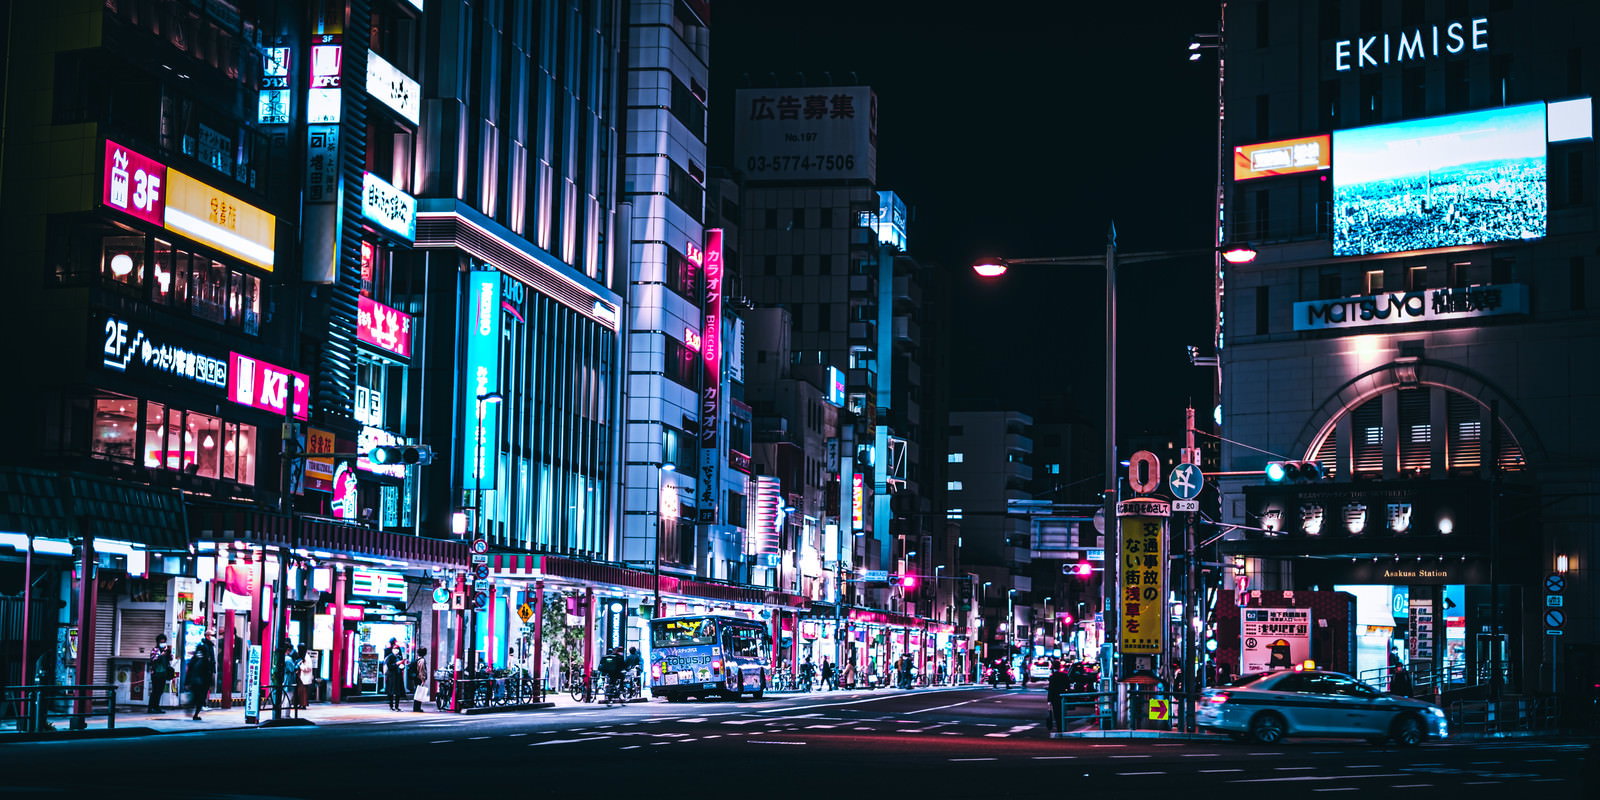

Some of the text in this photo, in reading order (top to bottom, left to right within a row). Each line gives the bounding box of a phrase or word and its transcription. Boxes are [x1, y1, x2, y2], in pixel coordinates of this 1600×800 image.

[322, 34, 334, 43] 3F
[1336, 18, 1488, 71] EKIMISE
[312, 76, 339, 88] KFC
[750, 94, 855, 121] 広告募集
[746, 154, 855, 172] 03-5774-7506
[133, 169, 160, 212] 3F
[707, 250, 720, 303] カラオケ
[105, 317, 127, 357] 2F
[260, 369, 305, 410] KFC
[702, 387, 718, 441] カラオケ
[1143, 522, 1159, 601] 交通事故の
[1384, 569, 1448, 577] Asakusa Station
[1125, 539, 1141, 634] ない街浅草を
[667, 653, 711, 666] tobus.jp
